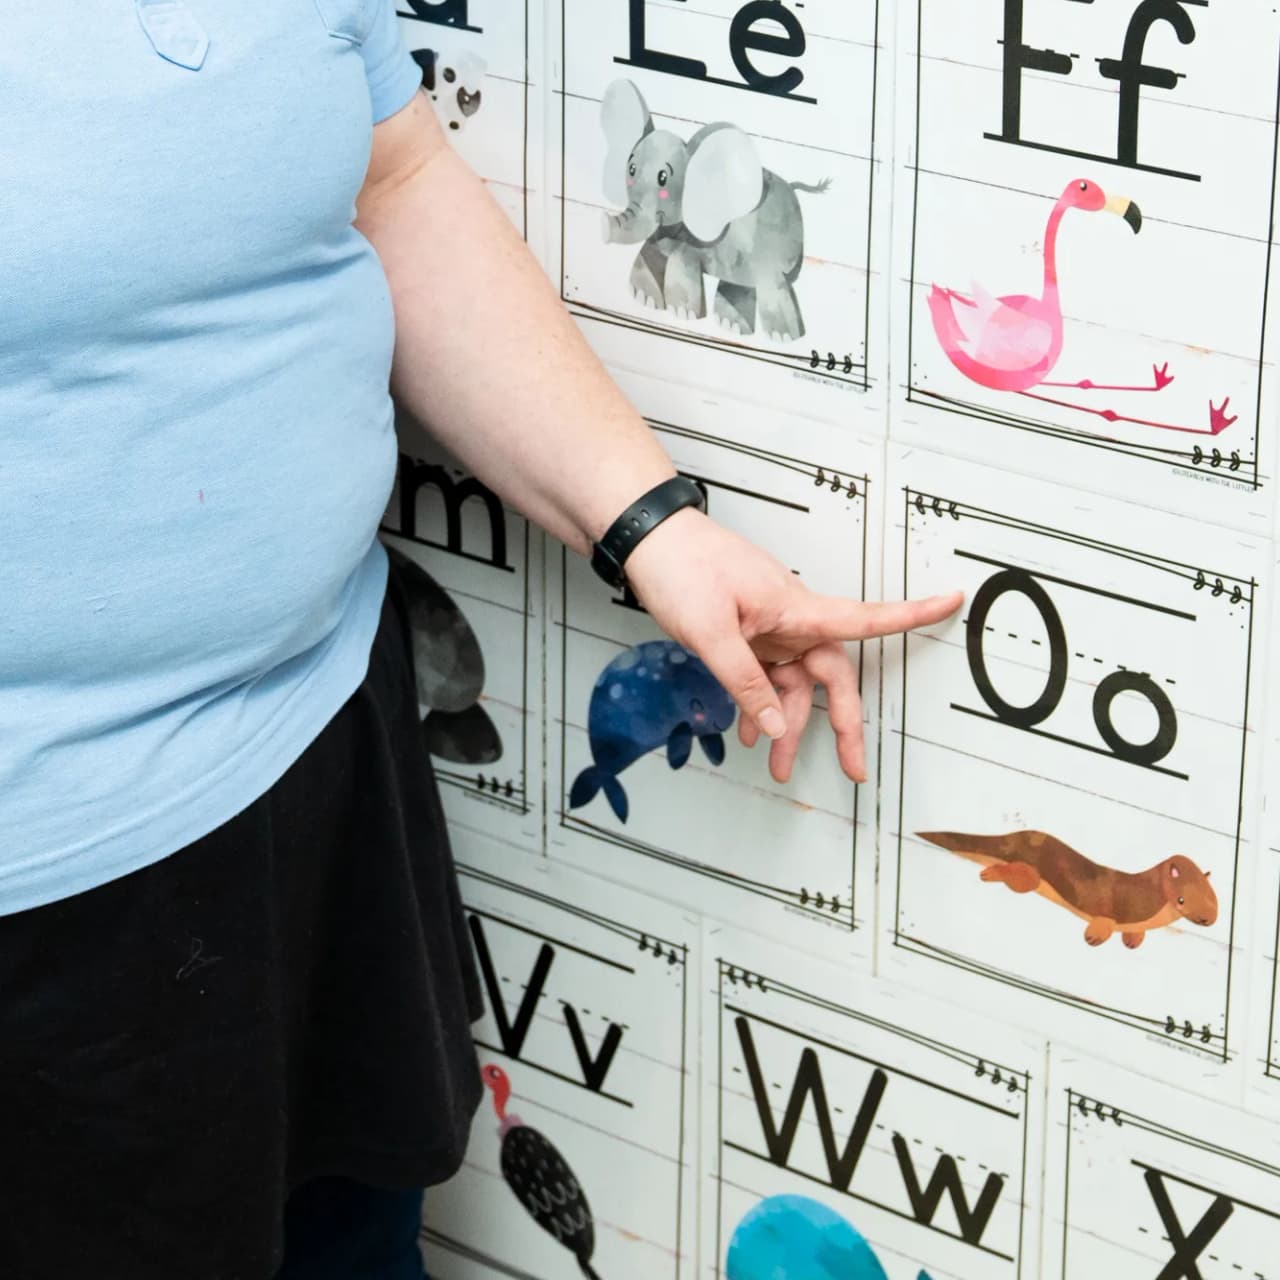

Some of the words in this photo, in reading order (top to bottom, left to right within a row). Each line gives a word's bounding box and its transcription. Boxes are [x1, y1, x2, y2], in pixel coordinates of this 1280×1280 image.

[965, 569, 1177, 766] Oo
[469, 914, 624, 1092] Vv
[735, 1017, 1005, 1245] Ww
